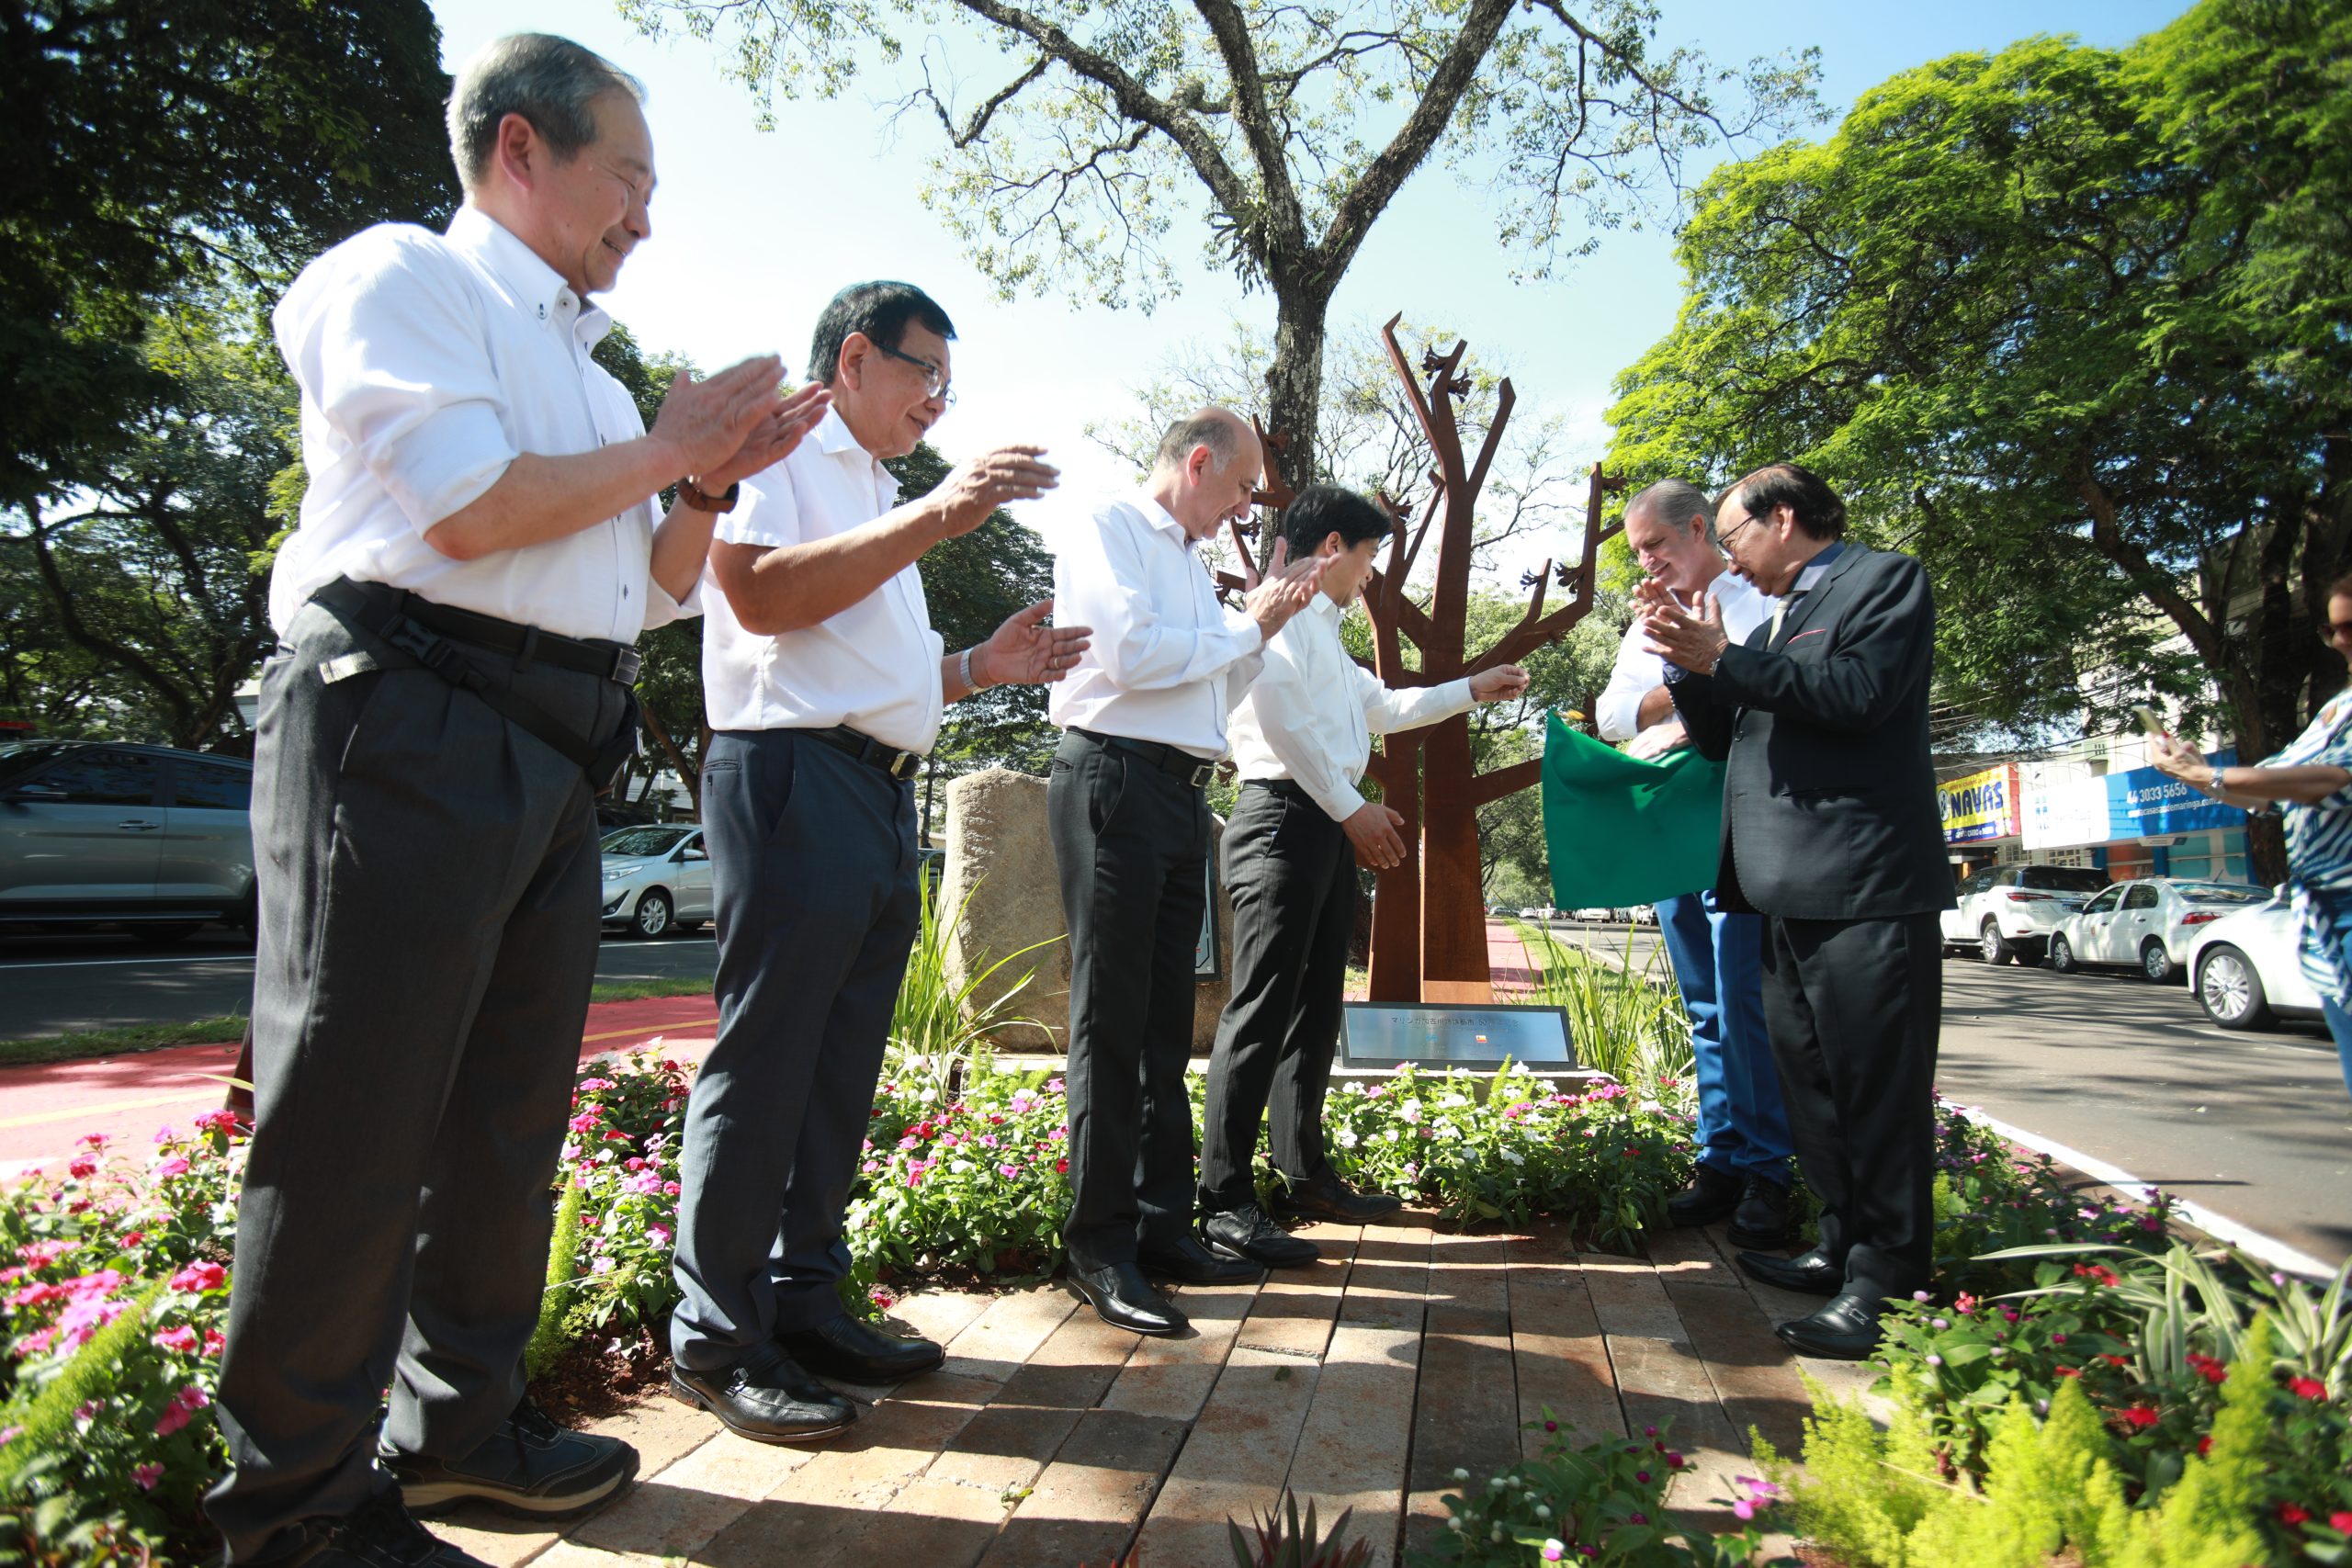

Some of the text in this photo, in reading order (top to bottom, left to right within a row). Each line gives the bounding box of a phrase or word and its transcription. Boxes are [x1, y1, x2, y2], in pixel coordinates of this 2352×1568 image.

[1951, 781, 2004, 818] NAVAS
[2126, 782, 2188, 804] 44 3033 5656
